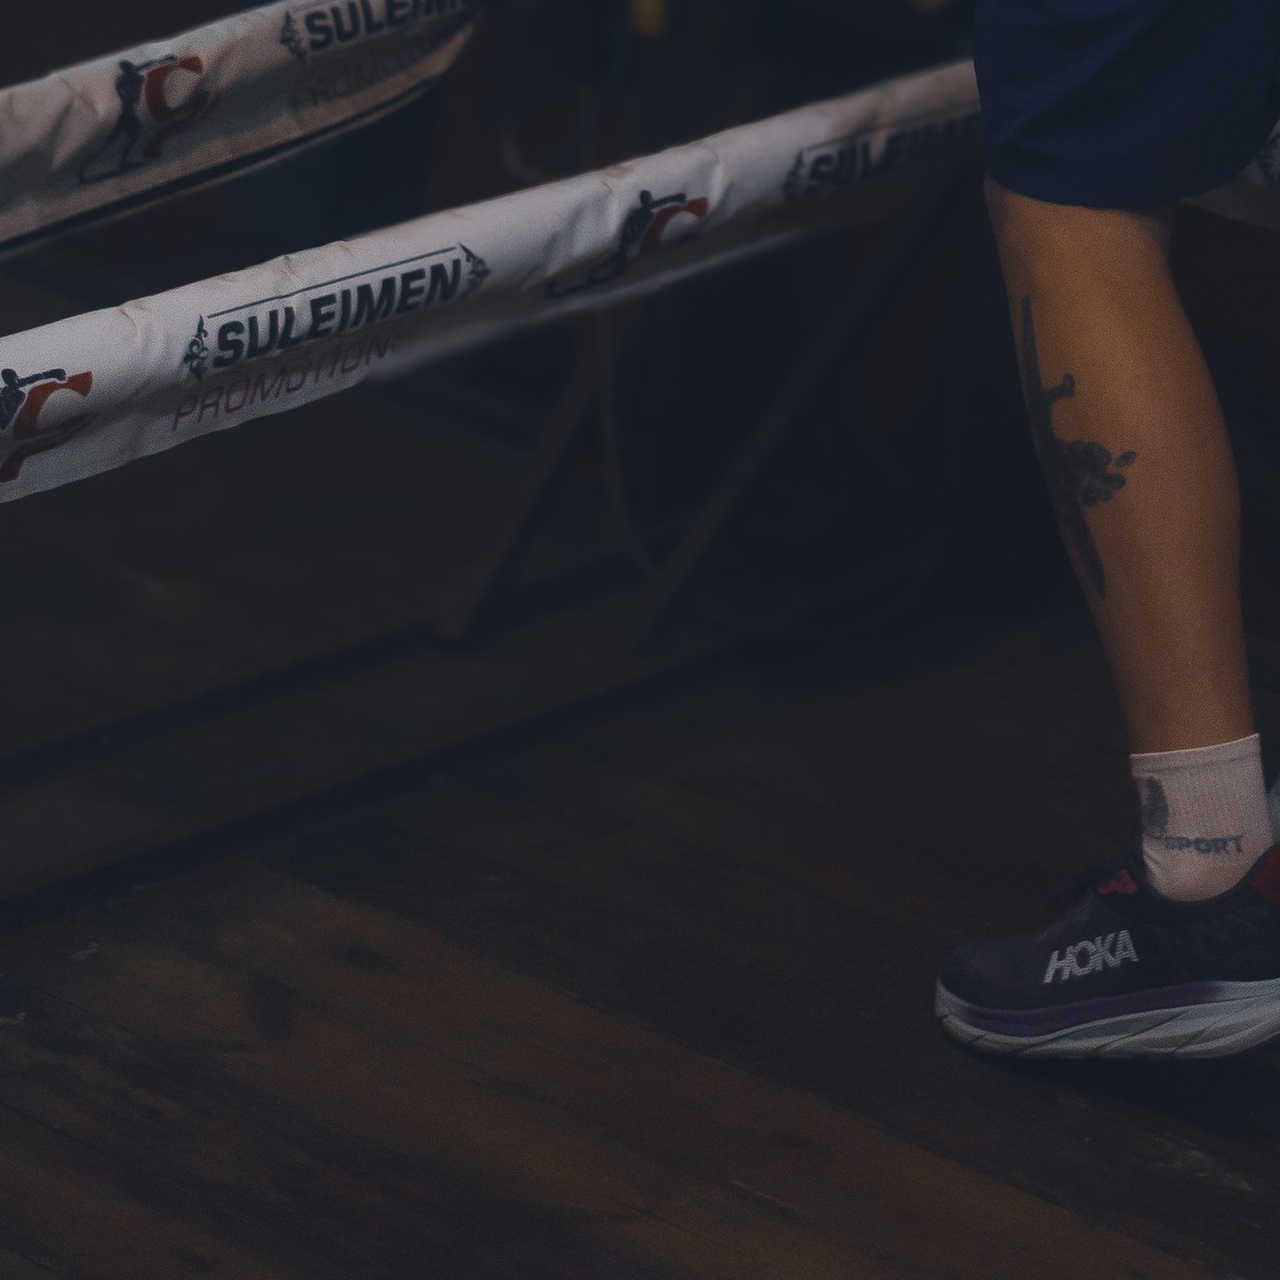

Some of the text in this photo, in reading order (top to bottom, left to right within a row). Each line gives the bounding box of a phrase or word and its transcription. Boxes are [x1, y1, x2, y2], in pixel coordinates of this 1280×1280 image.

[212, 258, 462, 369] SULEIMEN
[172, 333, 400, 432] PROMOTION
[1042, 929, 1139, 986] HOKA
